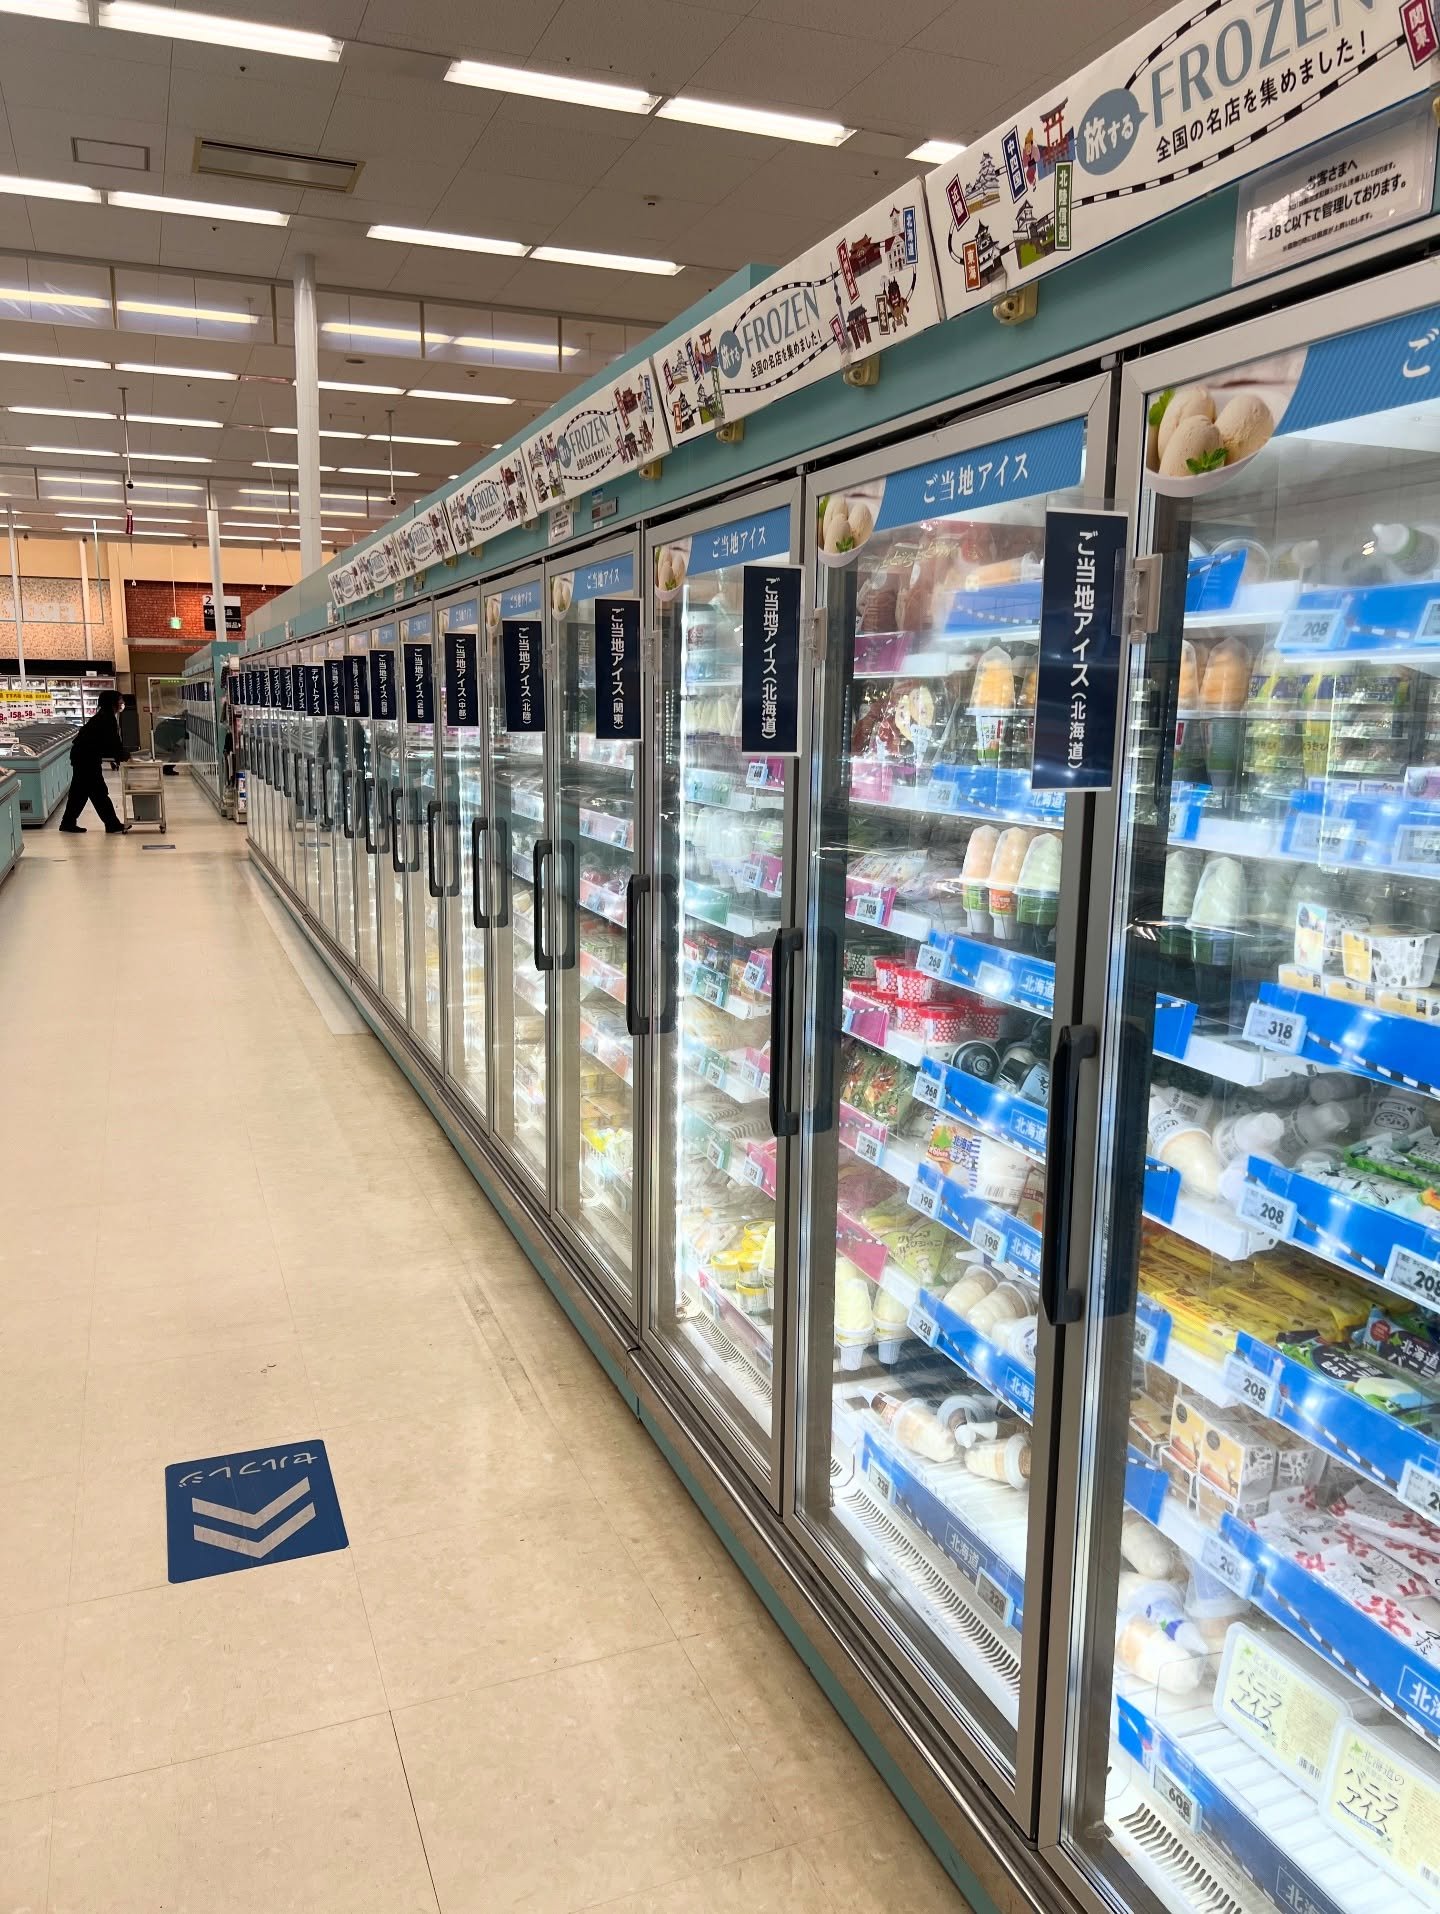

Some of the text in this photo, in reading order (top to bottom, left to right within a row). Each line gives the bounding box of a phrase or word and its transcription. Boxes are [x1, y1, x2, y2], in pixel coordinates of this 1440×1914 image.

[1083, 112, 1134, 164] 旅する
[742, 289, 820, 358] FROZEN
[569, 414, 612, 457] FROZEN
[923, 452, 1029, 503] ご当地アイス
[711, 525, 767, 559] ご当地アイス
[585, 567, 621, 590] ご当地アイス
[205, 595, 212, 605] 2
[1302, 621, 1329, 637] 208
[760, 577, 781, 739] ご当地アイス（北海道）
[1066, 530, 1099, 769] ご当地アイス（北海道）
[1267, 1020, 1293, 1039] 318
[925, 1084, 938, 1099] 268
[920, 1193, 934, 1209] 198
[1260, 1202, 1285, 1224] 208
[984, 1234, 999, 1250] 198
[918, 1318, 932, 1336] 228
[1243, 1378, 1267, 1402] 208
[949, 1532, 980, 1568] 北海道
[1169, 1787, 1190, 1818] 608
[1343, 1768, 1400, 1812] バニラ
[1345, 1786, 1389, 1834] アイス
